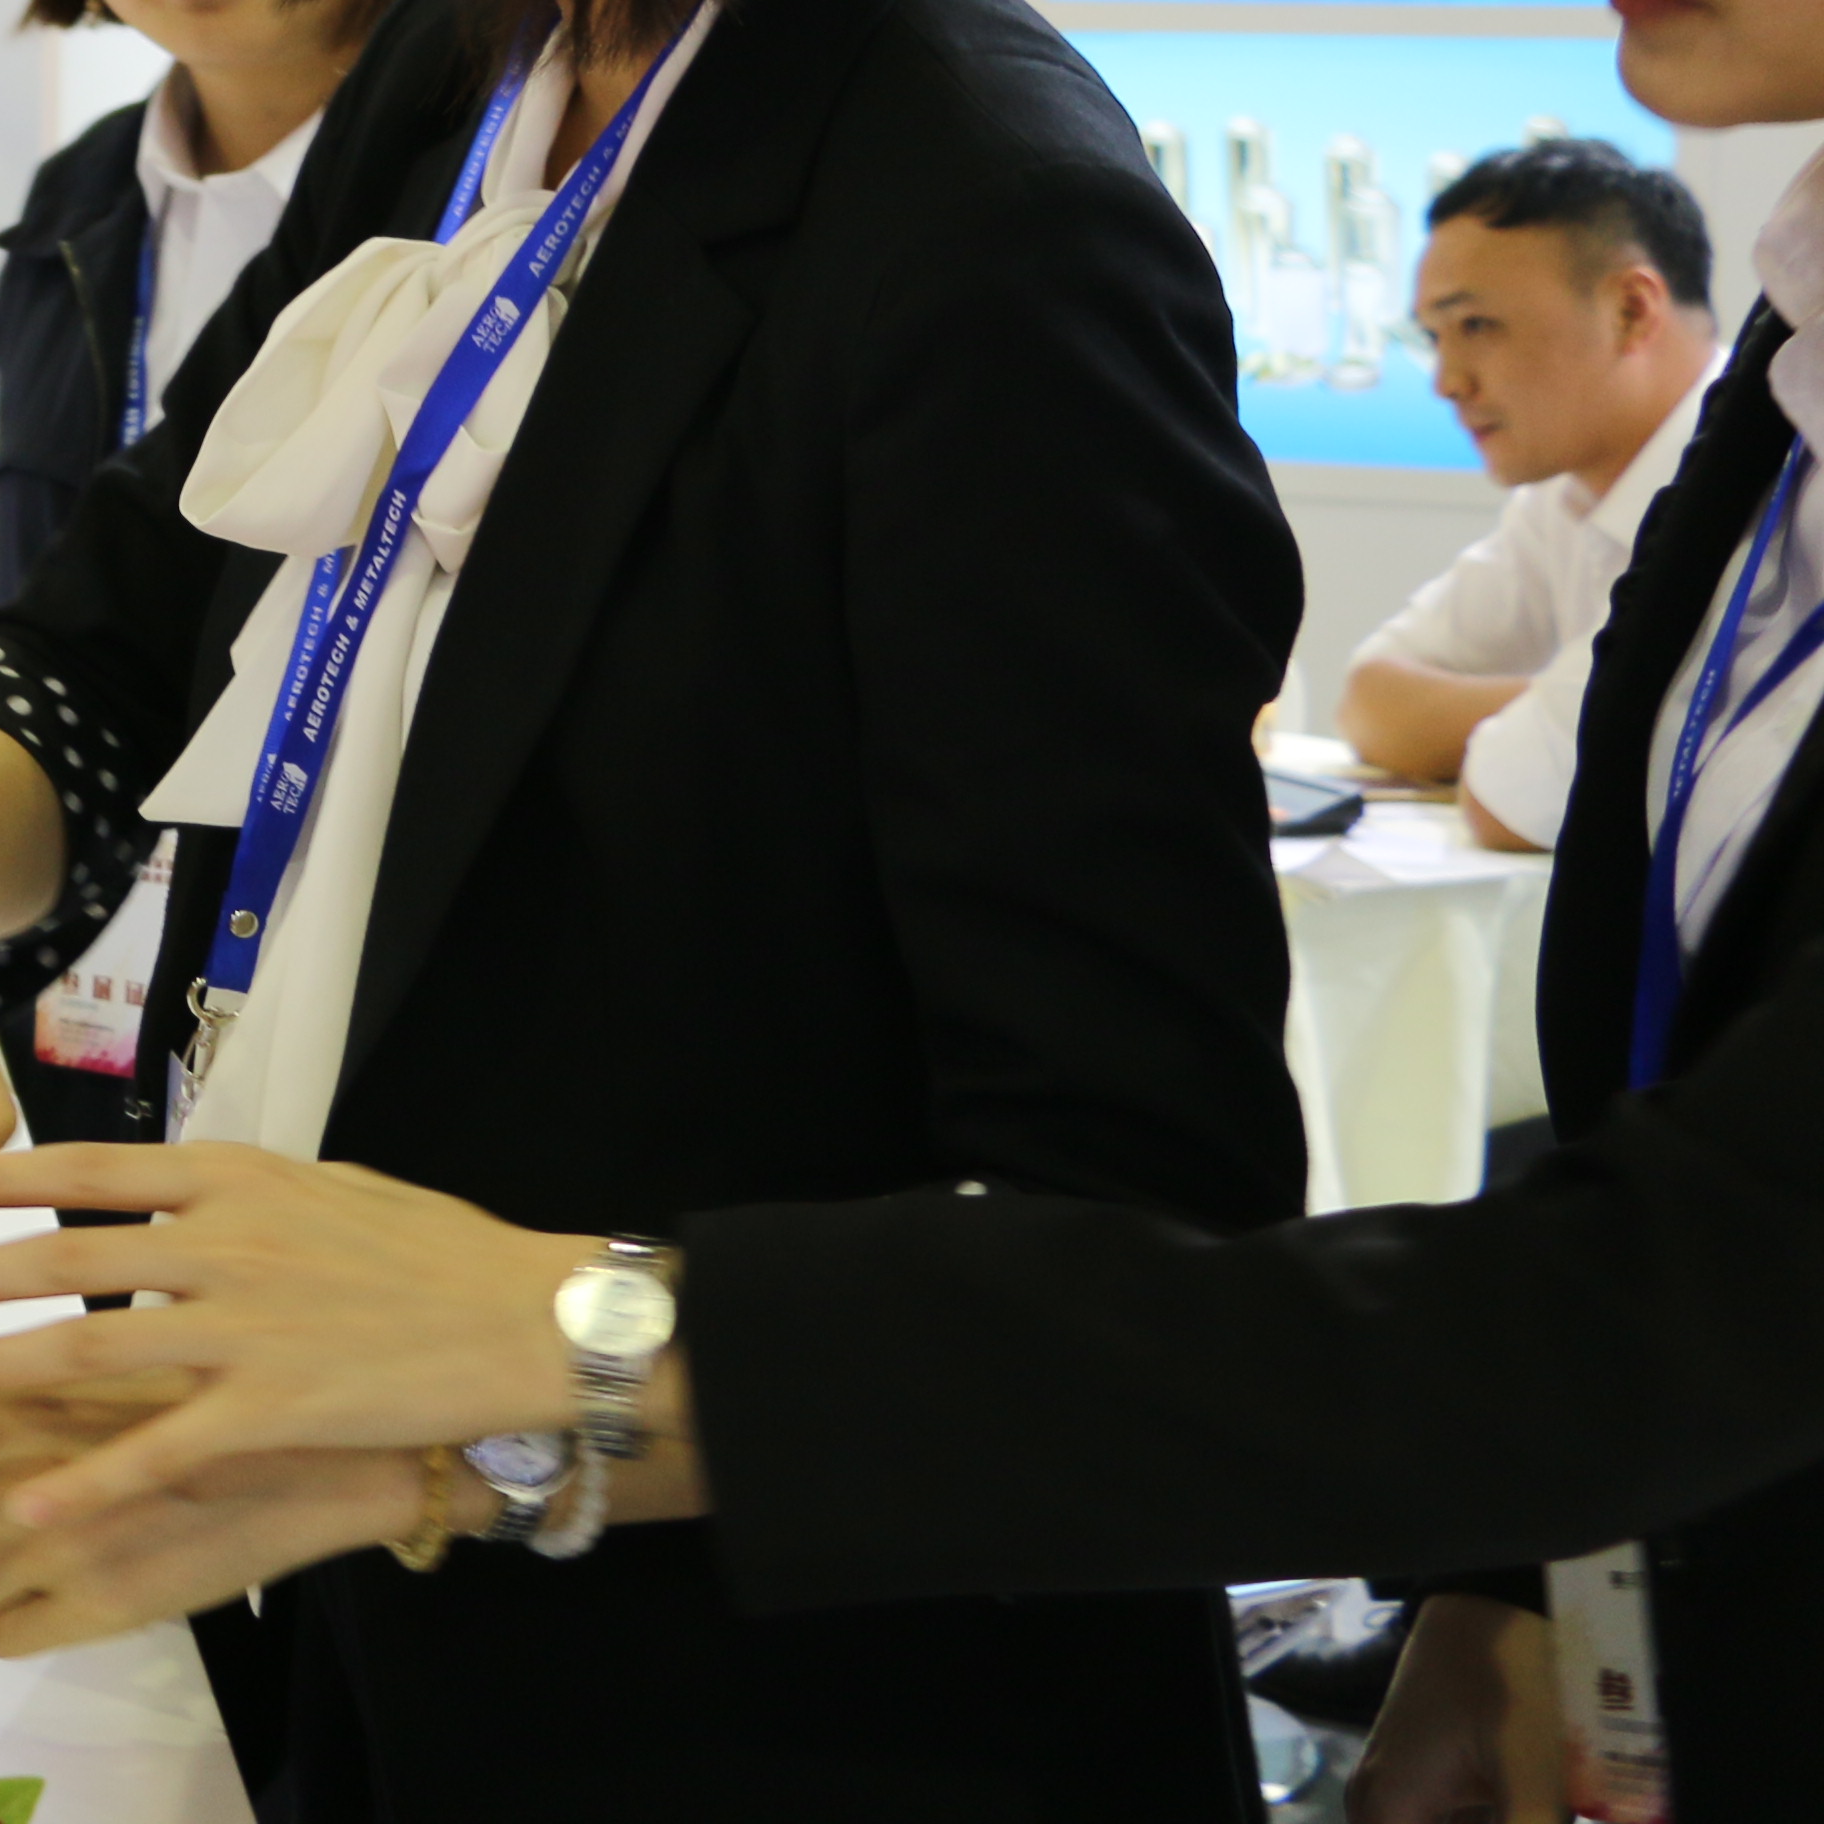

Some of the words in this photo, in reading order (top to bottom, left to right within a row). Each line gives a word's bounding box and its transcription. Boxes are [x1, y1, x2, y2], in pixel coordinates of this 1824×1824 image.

[528, 164, 602, 279] AEROTECH
[302, 632, 351, 743] AEROTECH
[345, 615, 359, 631] &
[353, 489, 407, 611] METALTECH
